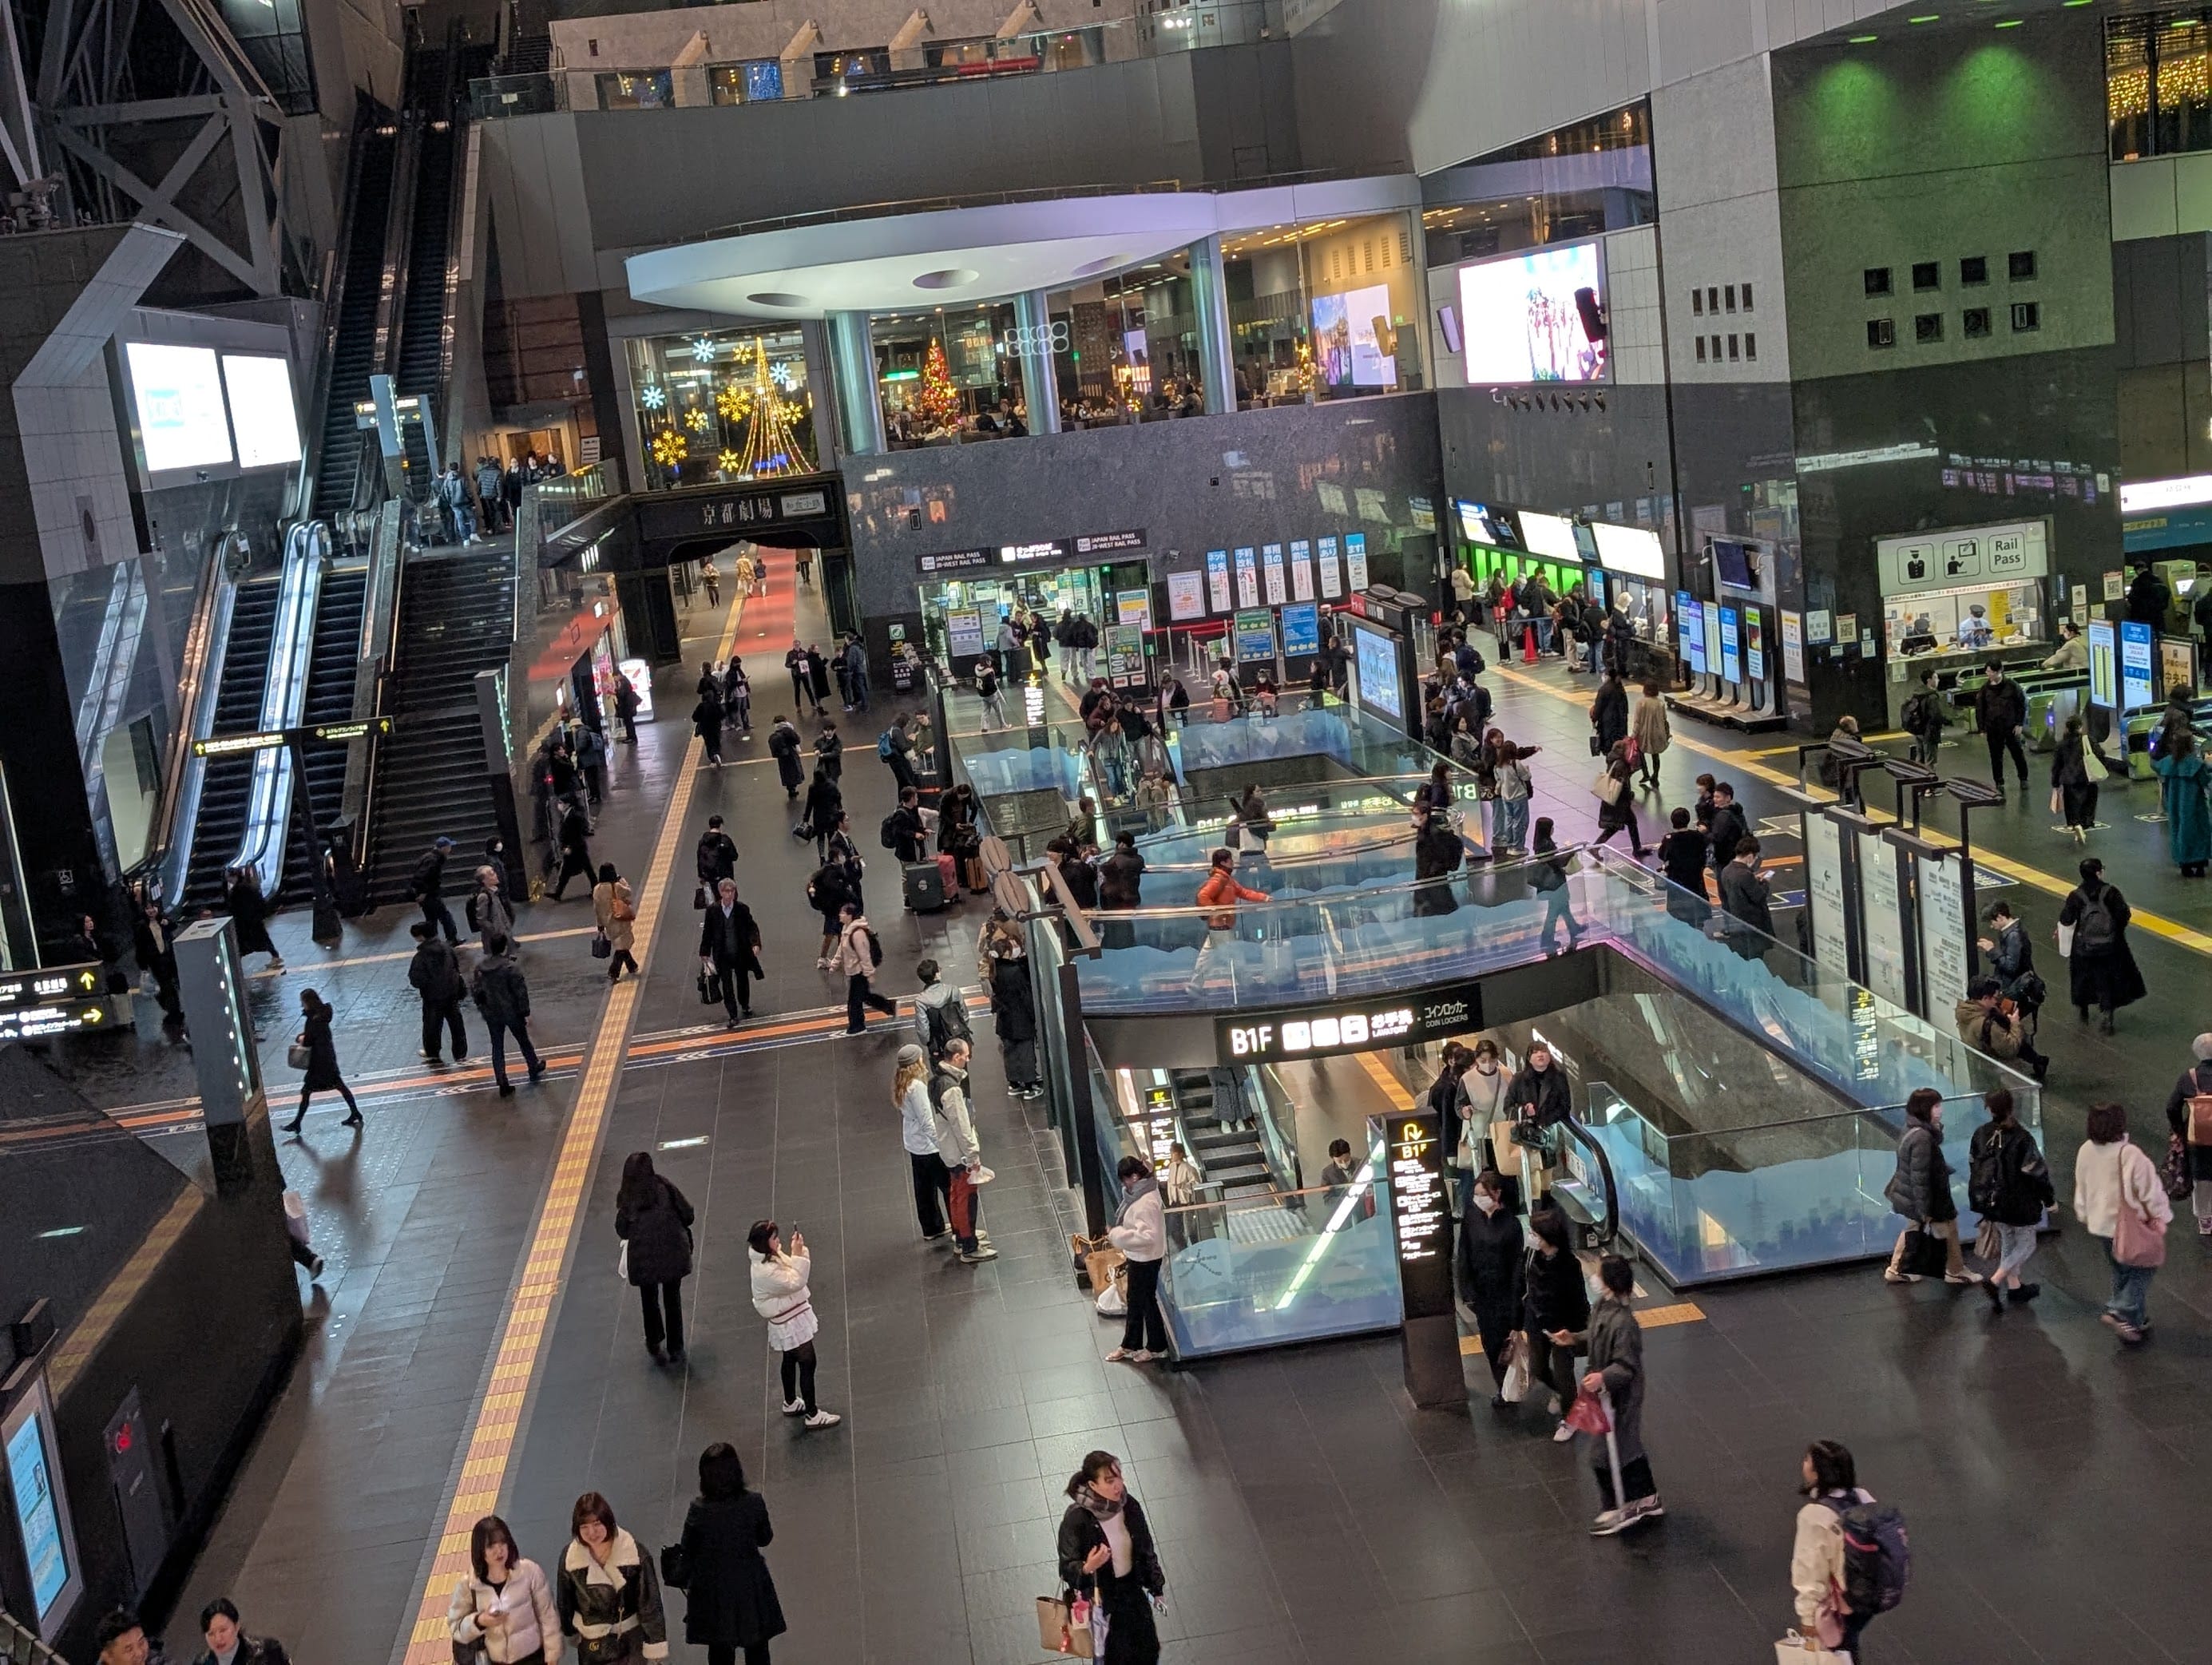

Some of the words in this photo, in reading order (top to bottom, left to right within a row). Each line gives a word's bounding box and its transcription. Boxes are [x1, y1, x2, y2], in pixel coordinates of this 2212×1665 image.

[702, 498, 773, 525] 京都劇場
[1995, 537, 2018, 551] Rail
[1320, 548, 1337, 557] あり
[1994, 553, 2021, 565] Pass
[976, 677, 984, 691] R
[2165, 672, 2189, 685] 中央口
[1231, 1026, 1272, 1055] B1F
[1371, 1008, 1413, 1029] お手洗
[1424, 999, 1468, 1019] コインロッカー
[1372, 1025, 1409, 1038] LAVATORY
[1425, 1018, 1441, 1029] COIN
[1441, 1013, 1469, 1026] LOCKERS
[1401, 1144, 1427, 1159] B1F
